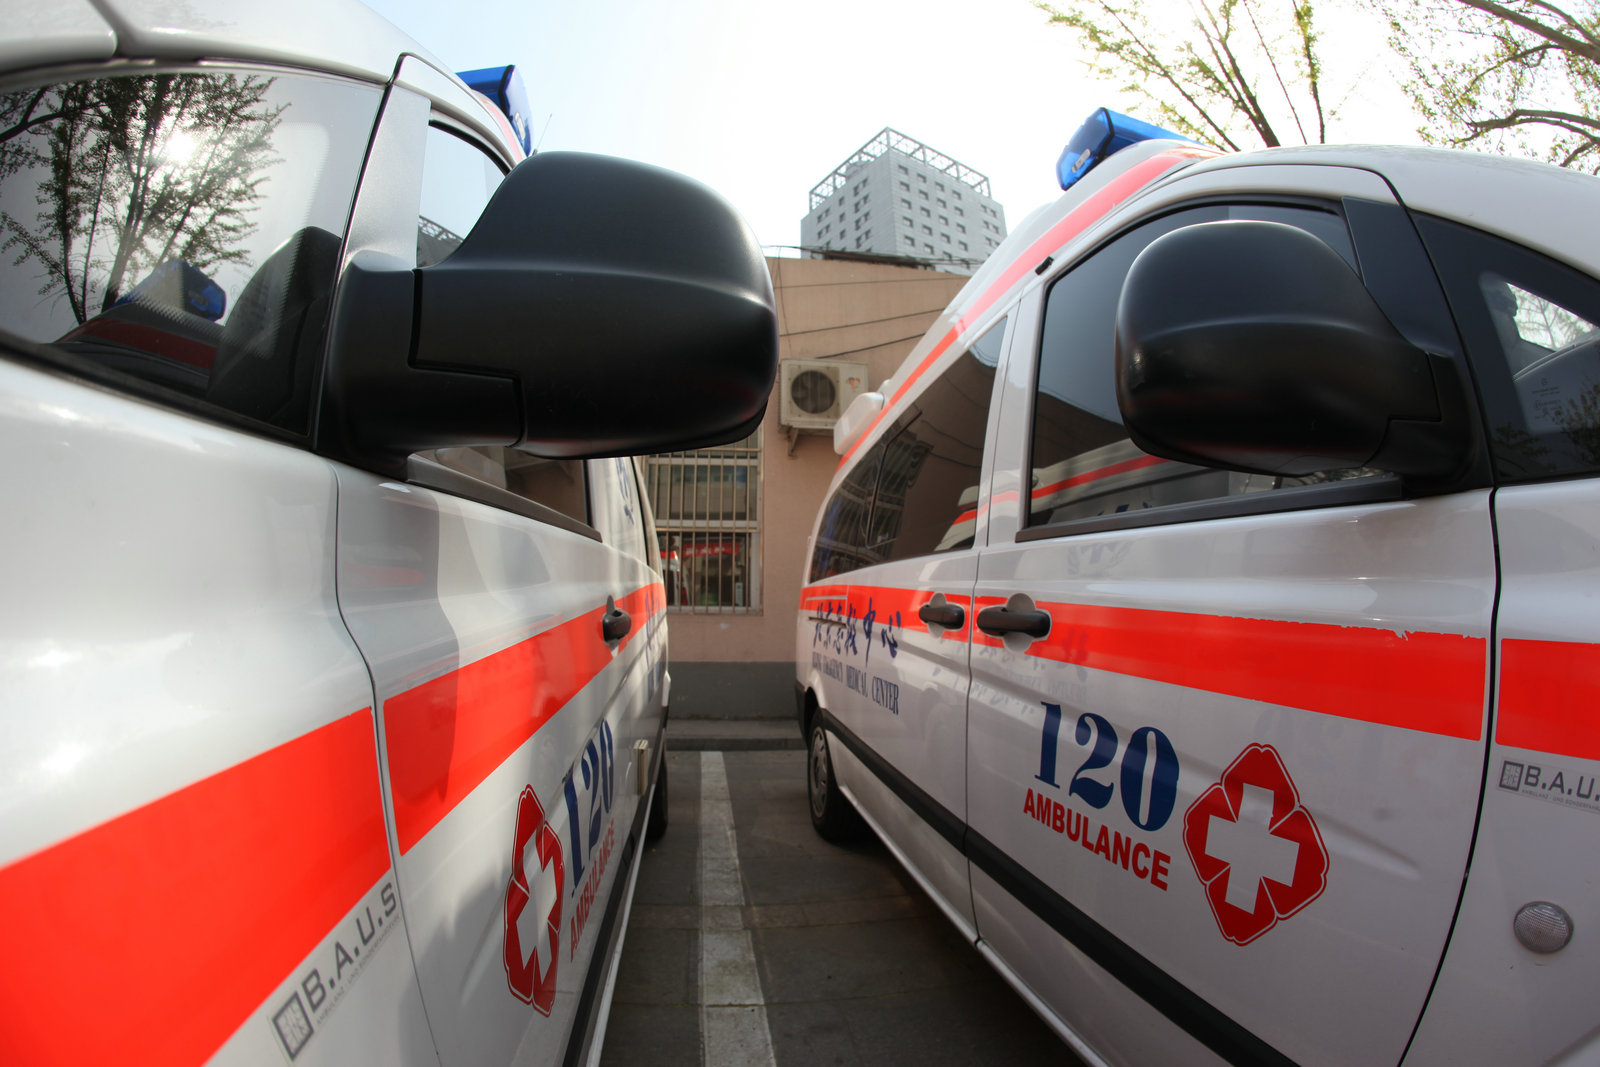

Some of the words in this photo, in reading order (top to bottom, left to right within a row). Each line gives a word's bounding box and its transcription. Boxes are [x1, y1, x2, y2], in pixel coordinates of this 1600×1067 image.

[872, 676, 899, 715] CENTER
[562, 719, 614, 898] 120
[1034, 701, 1180, 832] 120
[570, 817, 615, 963] AMBULANCE
[1023, 788, 1171, 892] AMBULANCE
[301, 882, 397, 1014] B.A.U.S
